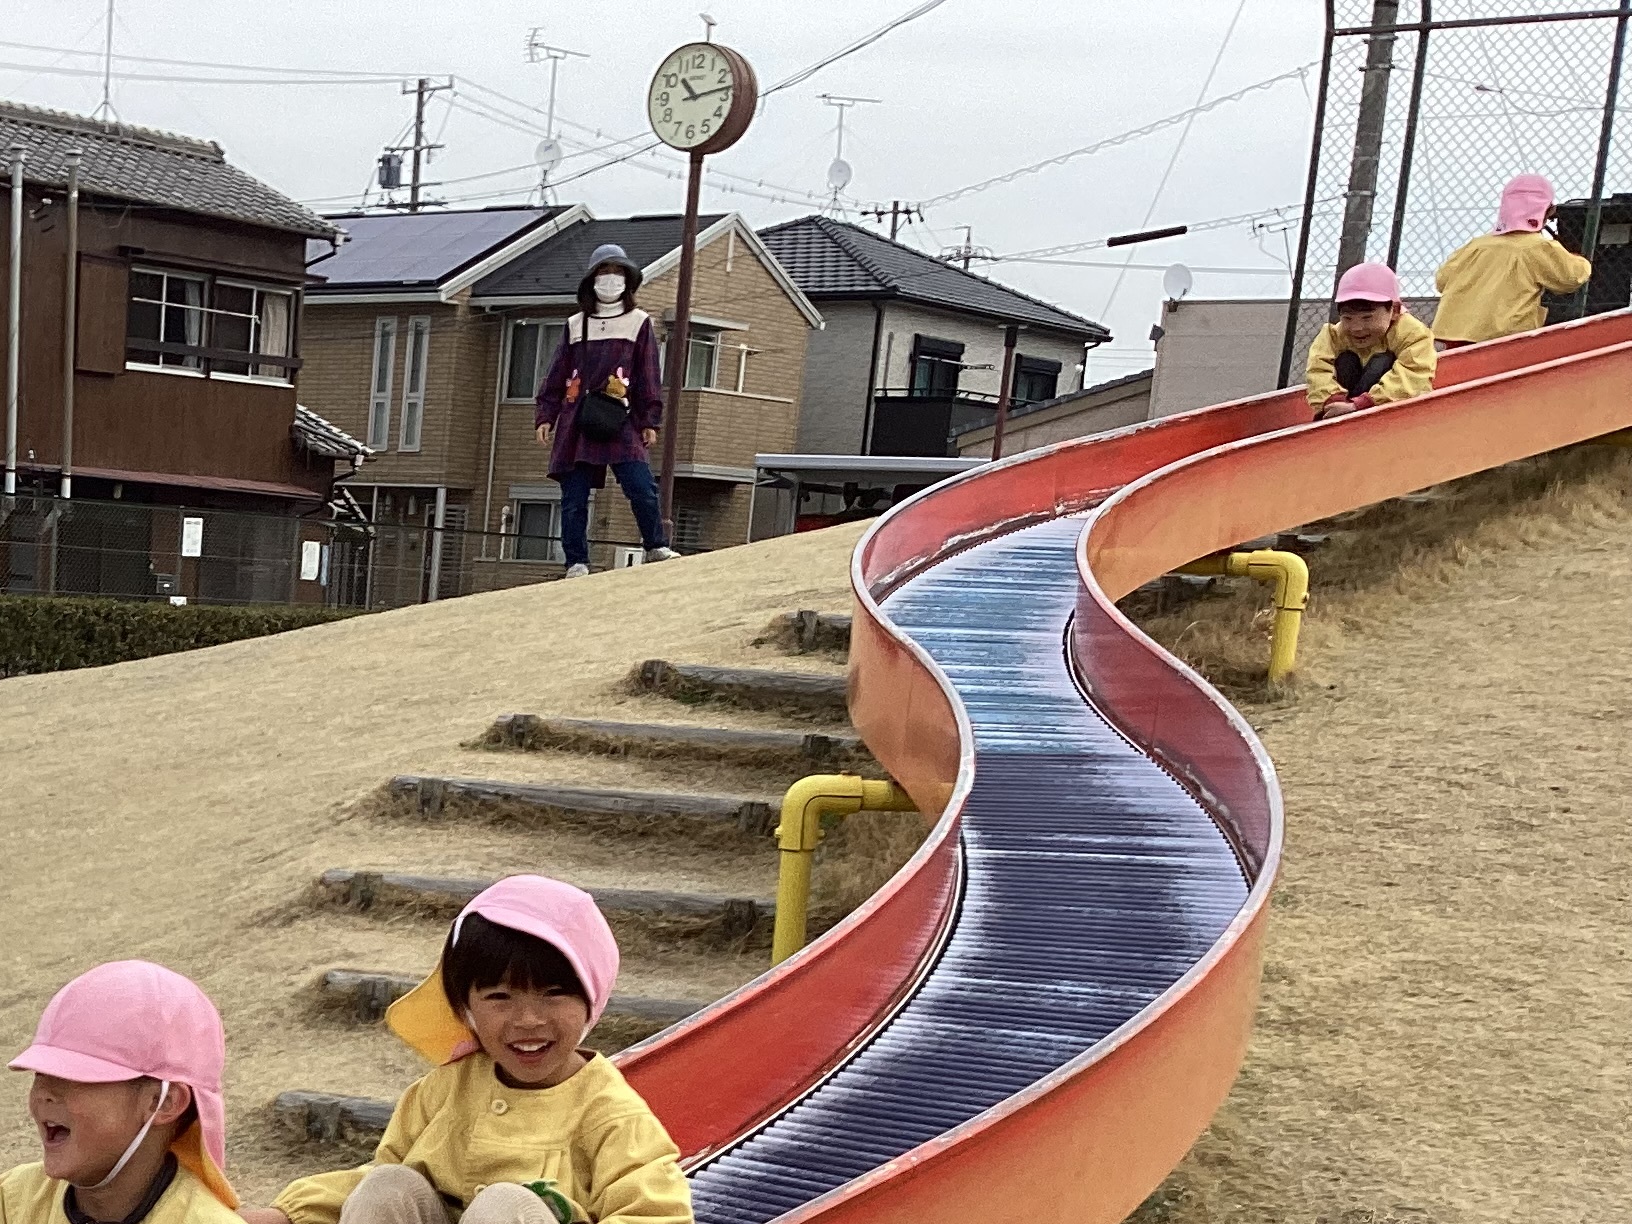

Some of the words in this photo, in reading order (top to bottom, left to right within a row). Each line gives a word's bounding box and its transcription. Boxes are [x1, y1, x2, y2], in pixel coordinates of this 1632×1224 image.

[678, 55, 689, 73] 11
[692, 54, 705, 69] 12
[709, 57, 715, 71] 1
[662, 73, 678, 88] 10
[717, 68, 727, 83] 2
[660, 92, 669, 106] 9
[720, 86, 730, 102] 3
[663, 108, 672, 123] 8
[713, 105, 722, 118] 4
[674, 121, 682, 136] 7
[685, 125, 695, 139] 6
[700, 119, 710, 134] 5
